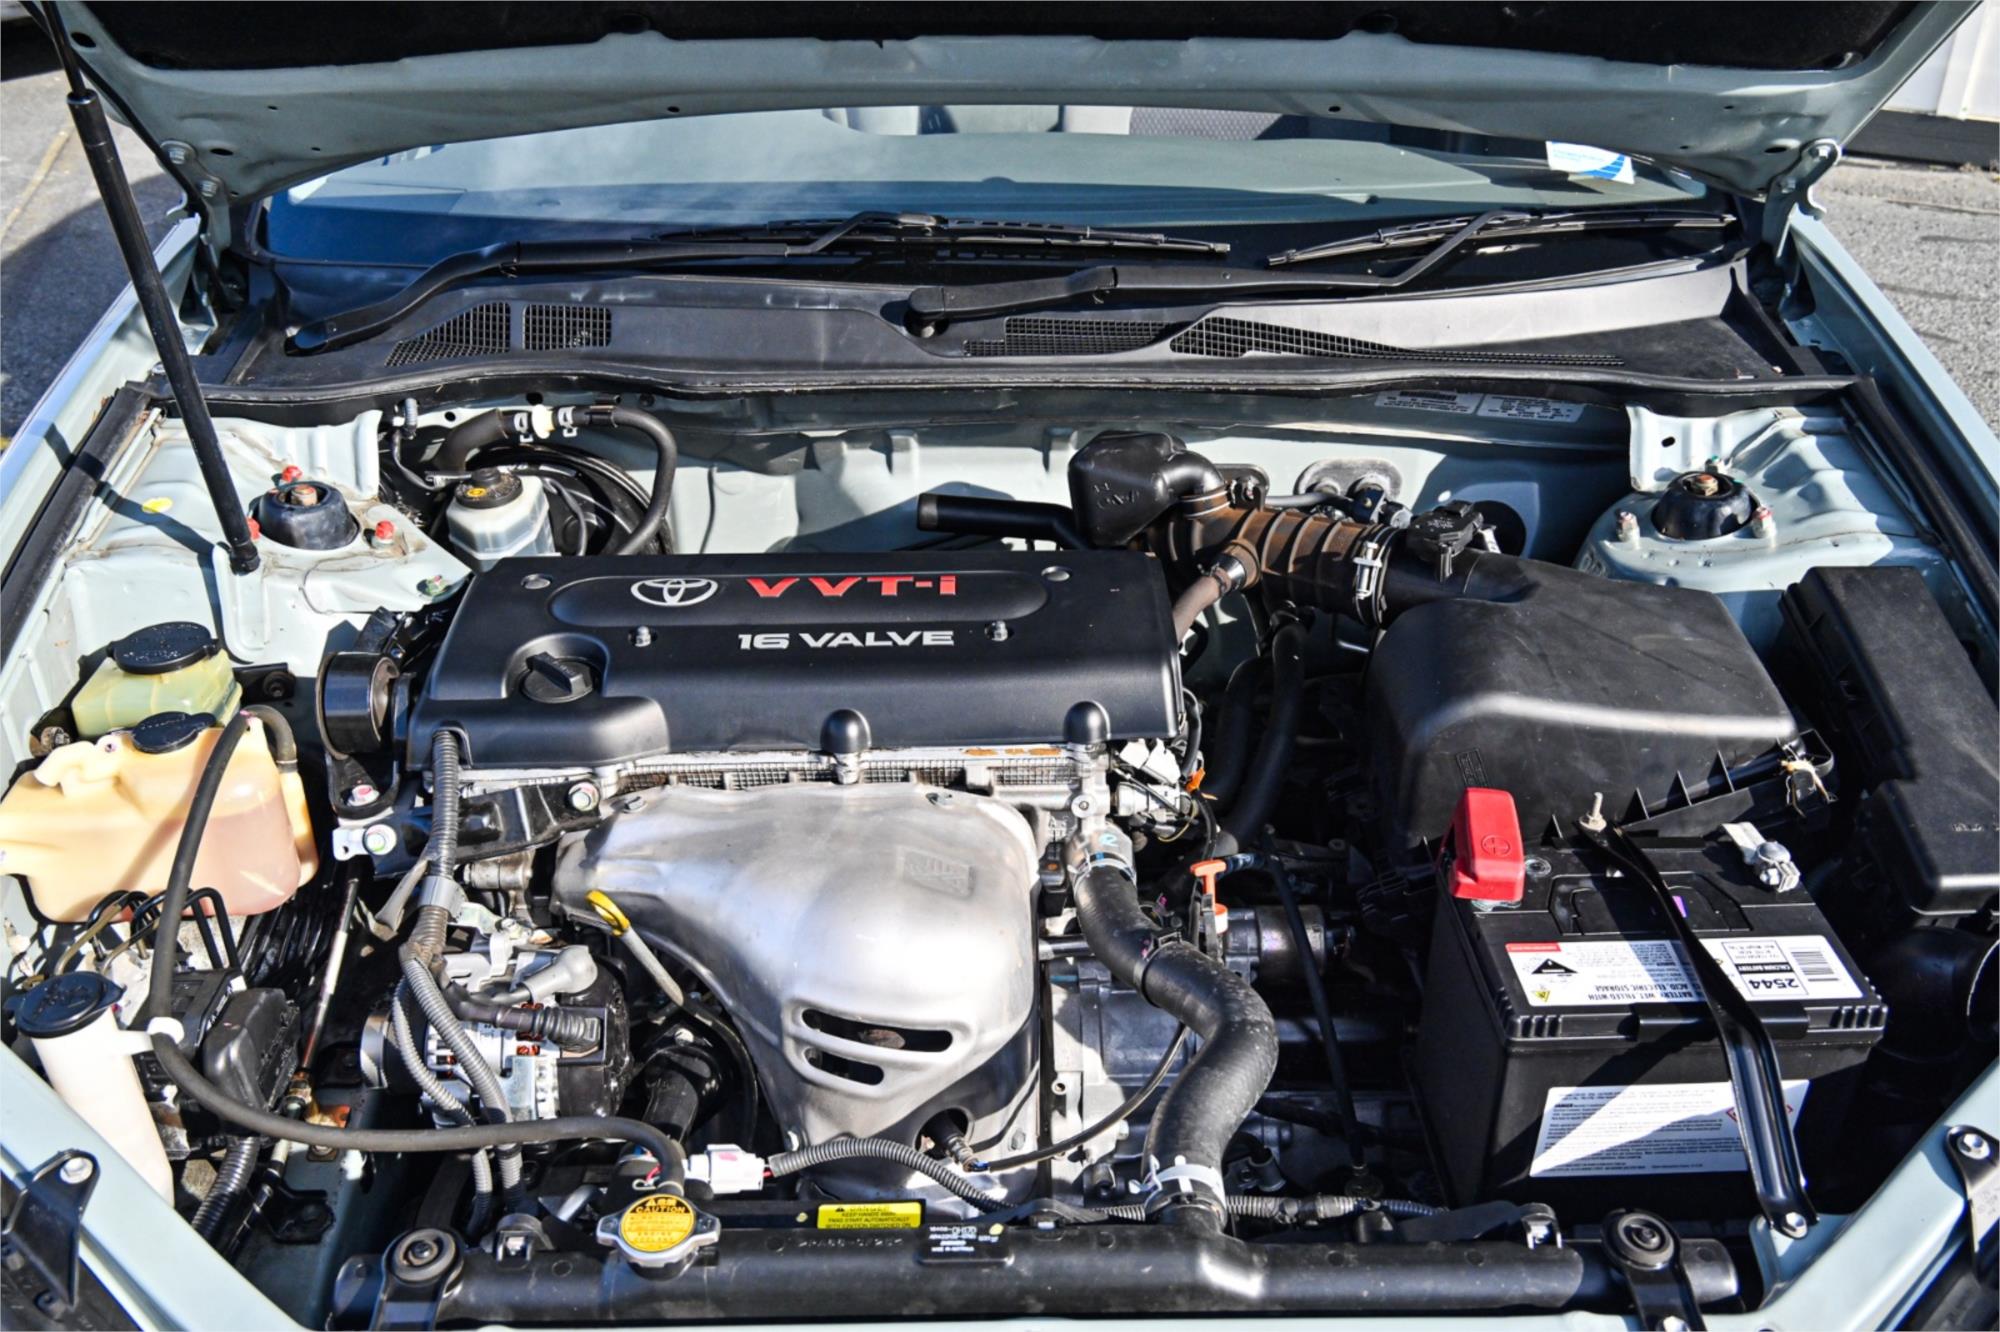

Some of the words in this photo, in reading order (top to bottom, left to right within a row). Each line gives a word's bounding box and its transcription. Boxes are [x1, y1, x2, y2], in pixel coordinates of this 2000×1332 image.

[738, 633, 790, 650] 16
[798, 631, 954, 648] VALVE
[1595, 984, 1629, 992] STORAGE
[1749, 978, 1799, 989] 2544
[635, 1206, 685, 1214] CAUTION
